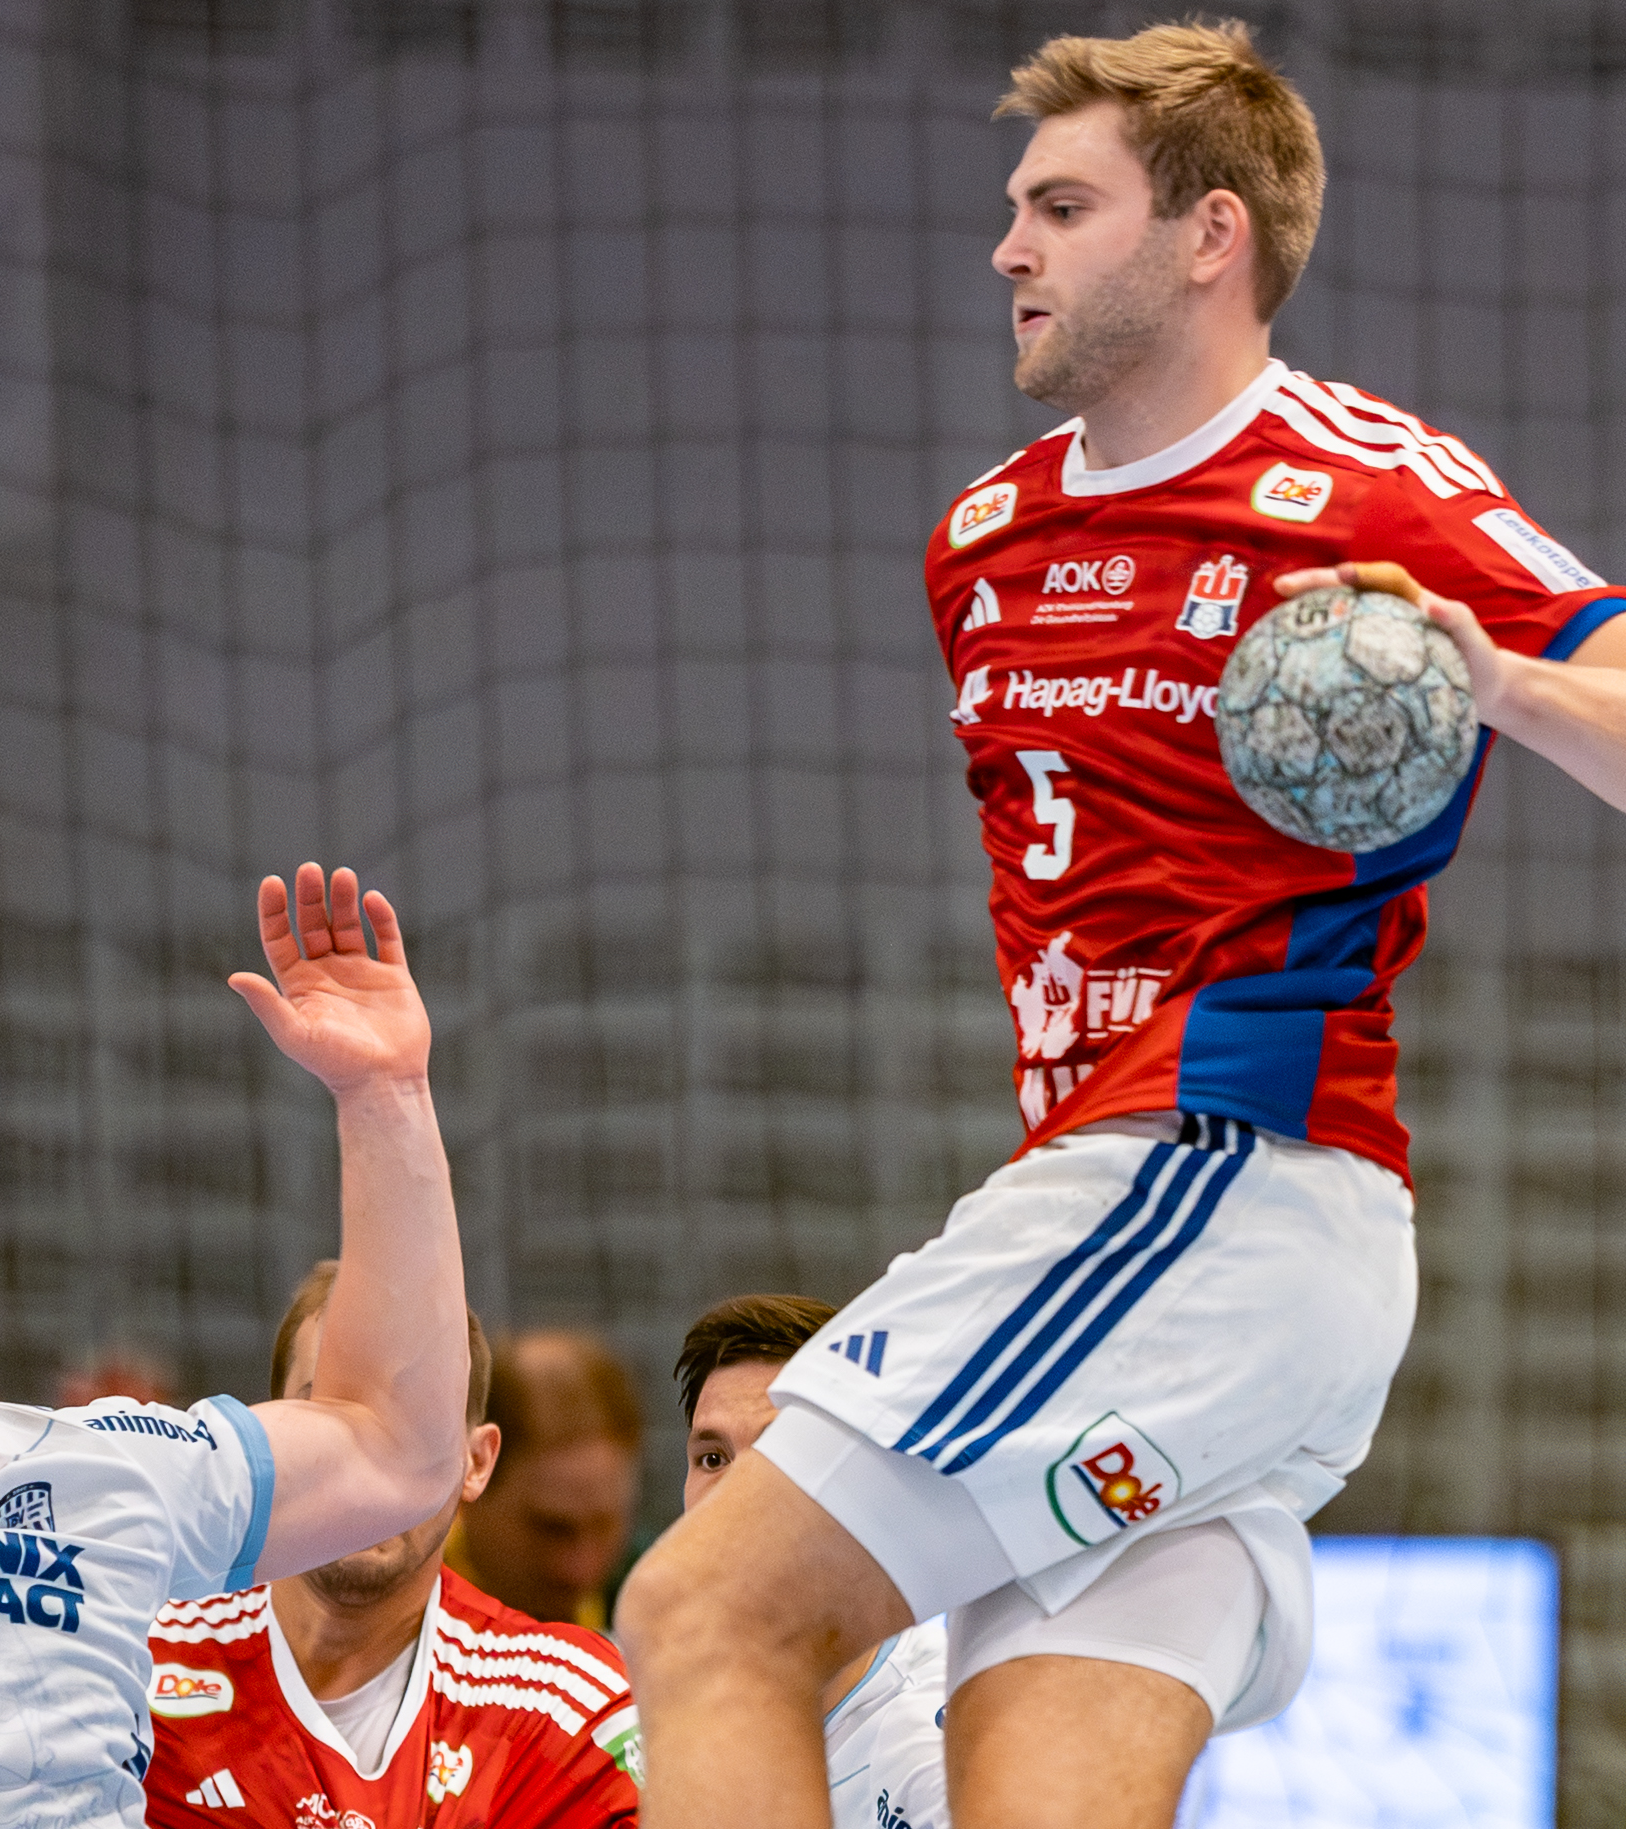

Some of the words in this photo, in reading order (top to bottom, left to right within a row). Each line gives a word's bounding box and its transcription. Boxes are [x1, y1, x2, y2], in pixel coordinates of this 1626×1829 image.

[1041, 560, 1103, 594] AOK
[1494, 512, 1592, 588] Leukotape
[1015, 749, 1075, 881] 5
[1080, 1441, 1164, 1524] Dole
